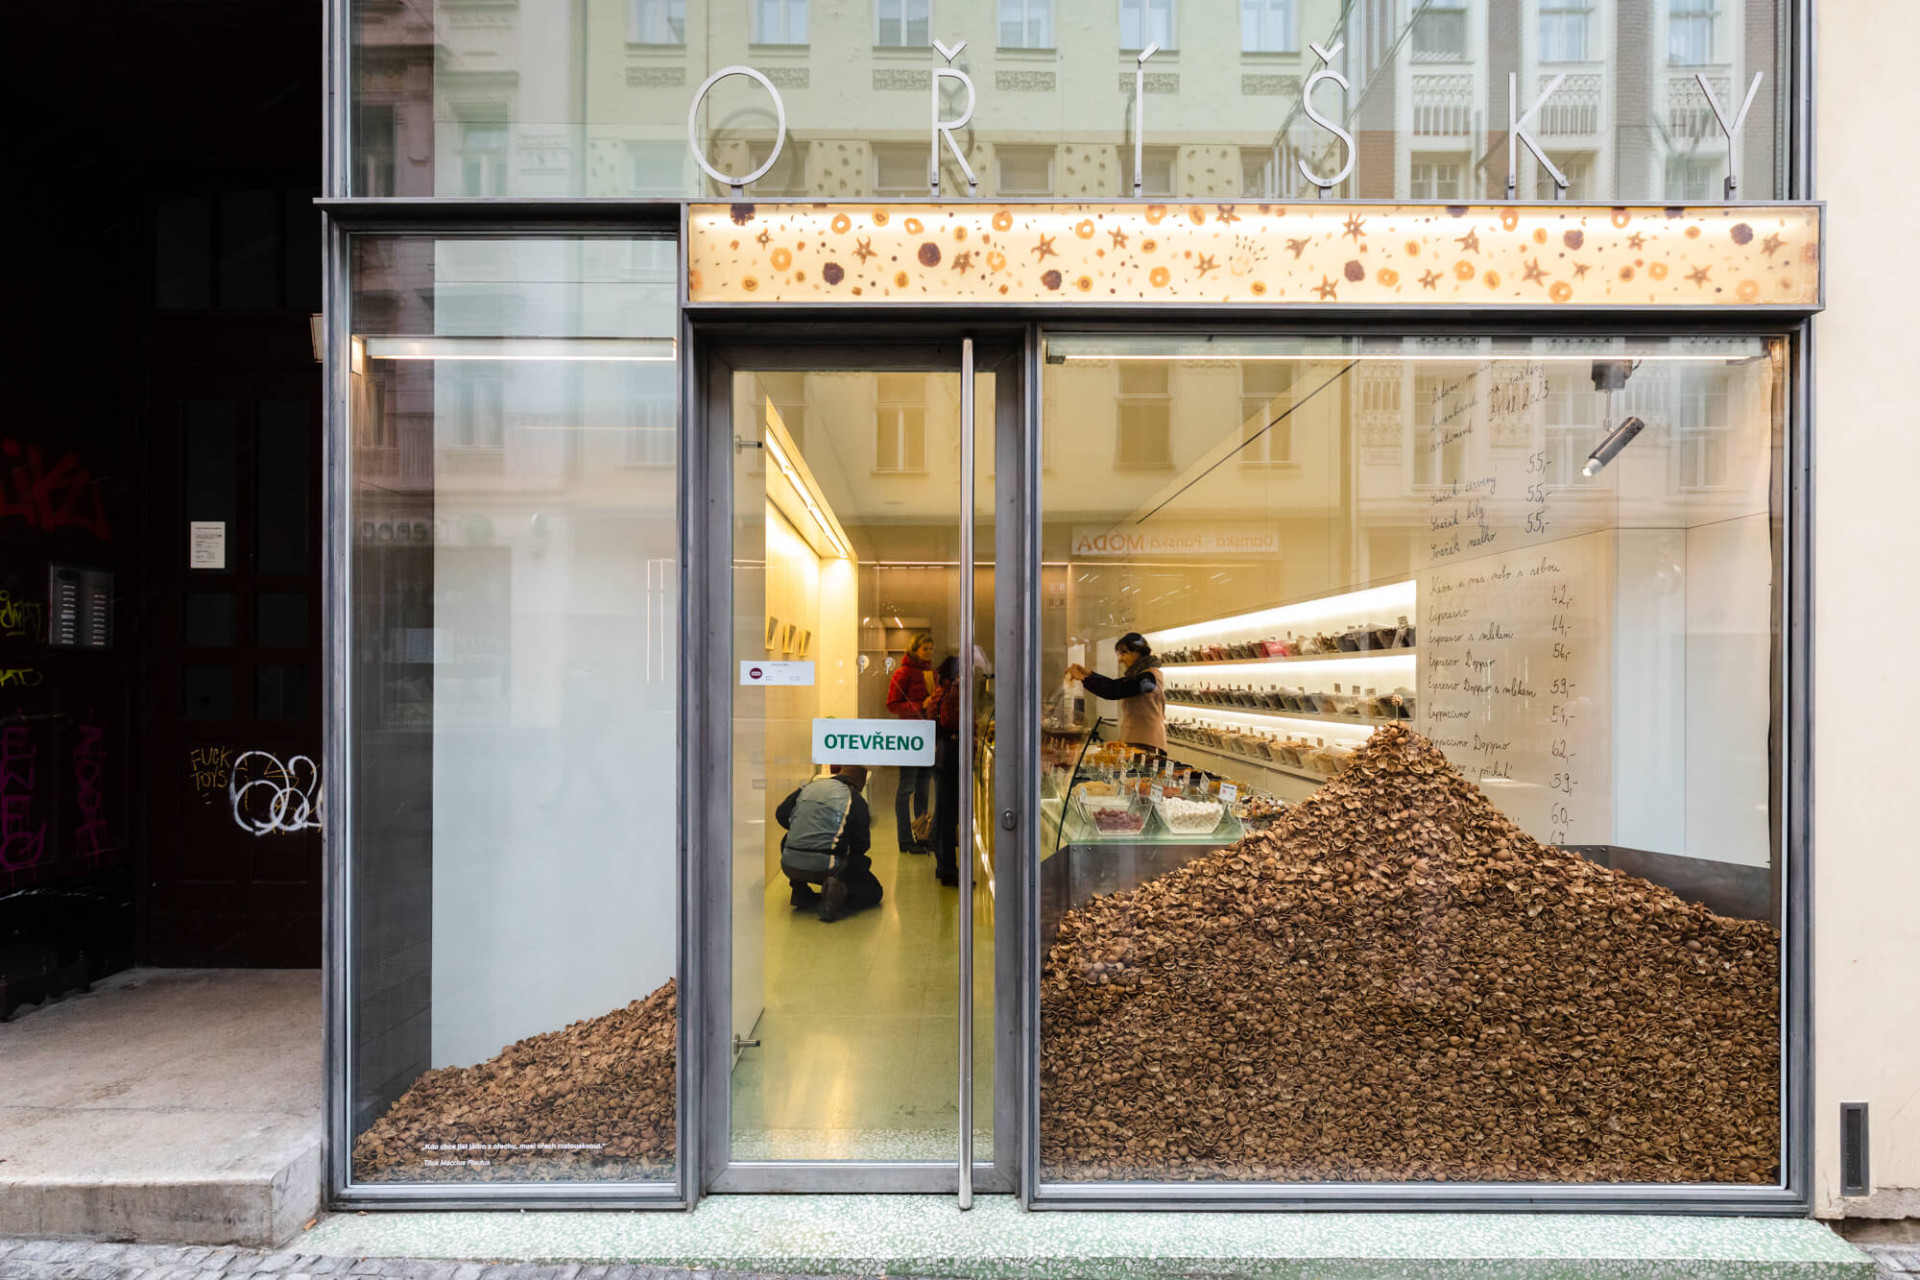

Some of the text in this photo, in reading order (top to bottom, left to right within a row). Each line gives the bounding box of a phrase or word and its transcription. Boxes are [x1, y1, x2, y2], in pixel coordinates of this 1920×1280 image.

[688, 40, 1764, 190] OŘÍŠKY
[1550, 677, 1576, 698] 59,-
[824, 731, 924, 751] OTEVŘENO
[1473, 732, 1511, 756] Doppio
[191, 746, 231, 771] FUCK
[191, 765, 228, 790] TOYS
